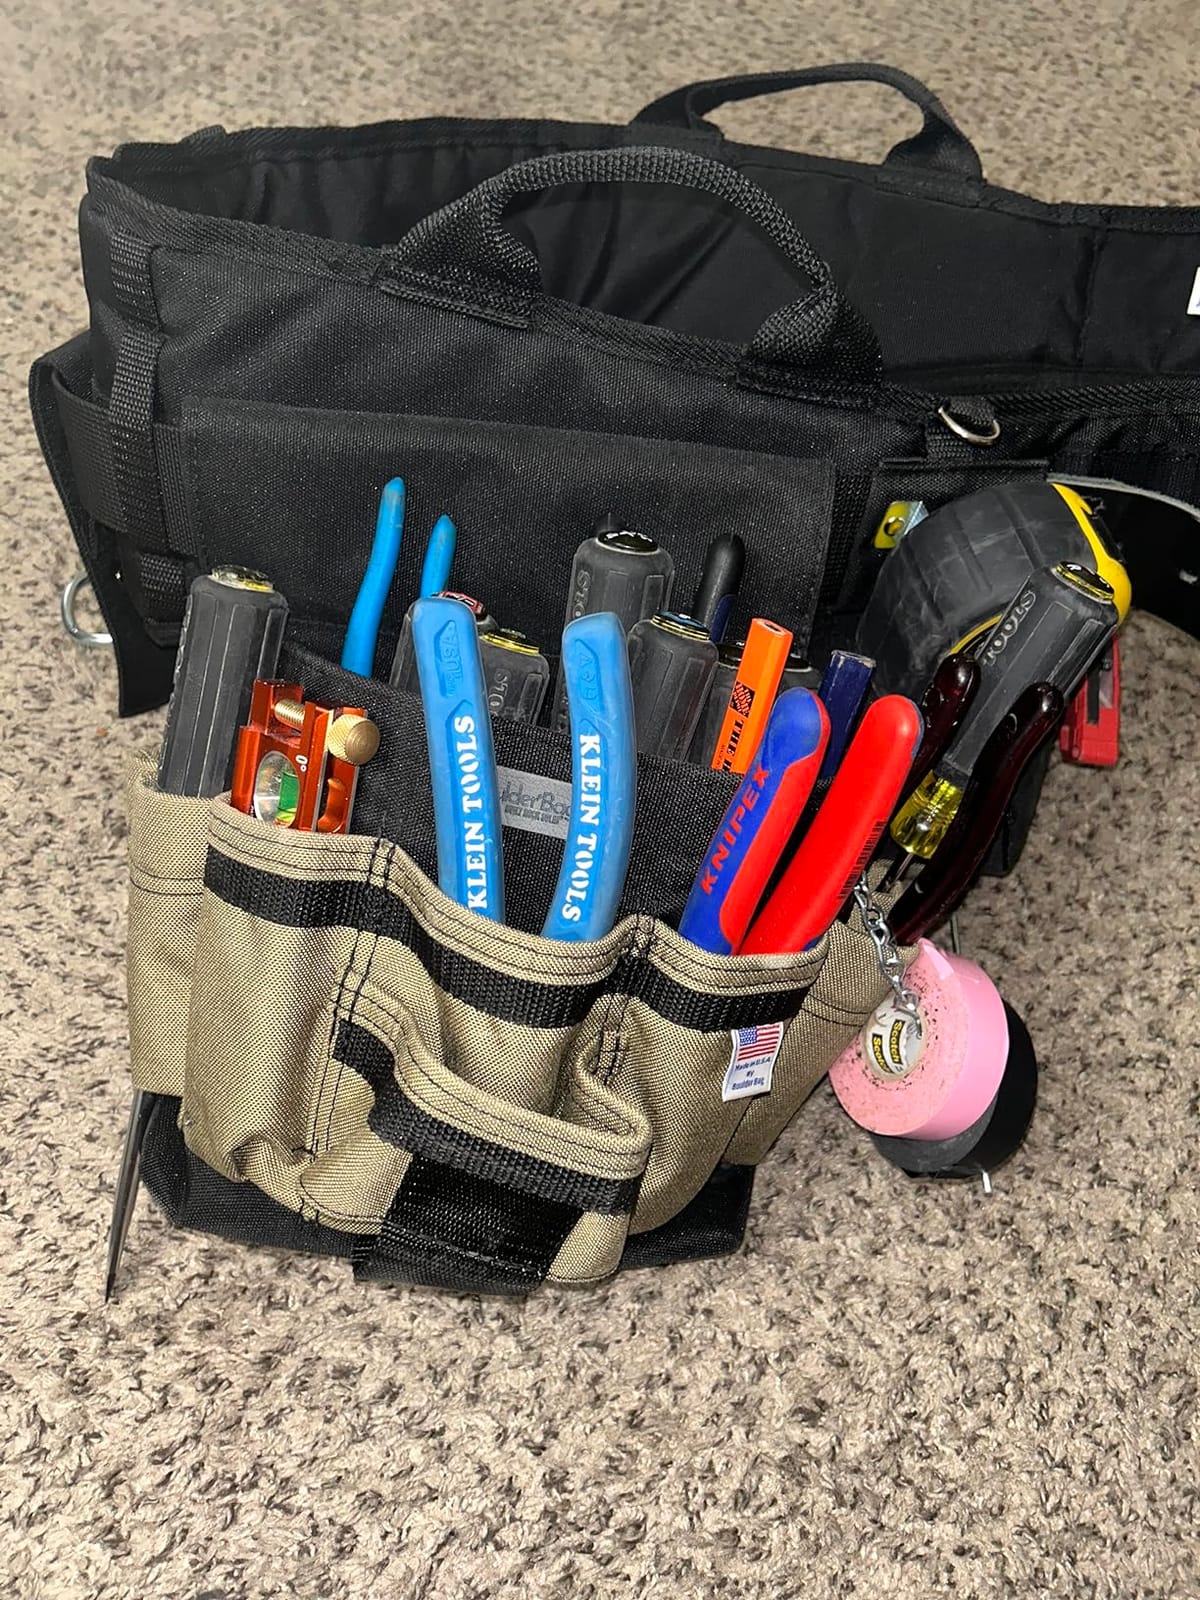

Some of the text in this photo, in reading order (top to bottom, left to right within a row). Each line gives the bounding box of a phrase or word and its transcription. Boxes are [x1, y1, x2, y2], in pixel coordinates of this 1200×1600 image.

[454, 715, 483, 814] TOOLS
[578, 733, 601, 826] KLEIN
[463, 821, 488, 909] KLEIN
[561, 832, 597, 923] TOOLS
[701, 768, 771, 896] KNIPEX
[890, 1020, 904, 1063] Scotch
